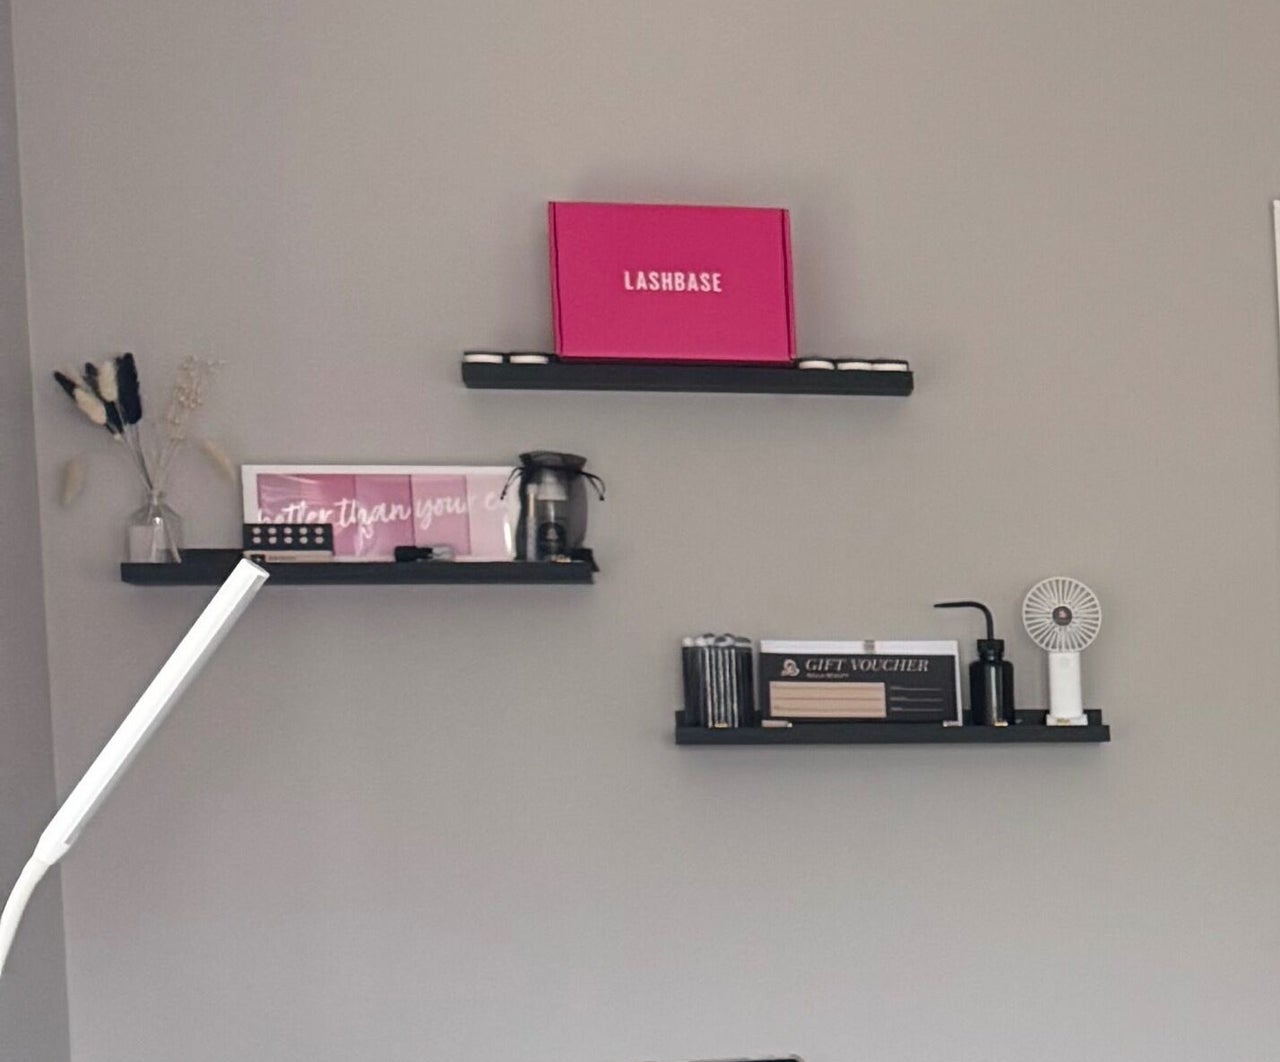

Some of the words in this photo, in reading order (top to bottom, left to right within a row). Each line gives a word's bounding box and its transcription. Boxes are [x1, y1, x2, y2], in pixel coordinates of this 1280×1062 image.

[624, 270, 722, 293] LASHBASE
[334, 498, 411, 528] than
[805, 658, 847, 671] GIFT
[849, 658, 929, 672] VOUCHER
